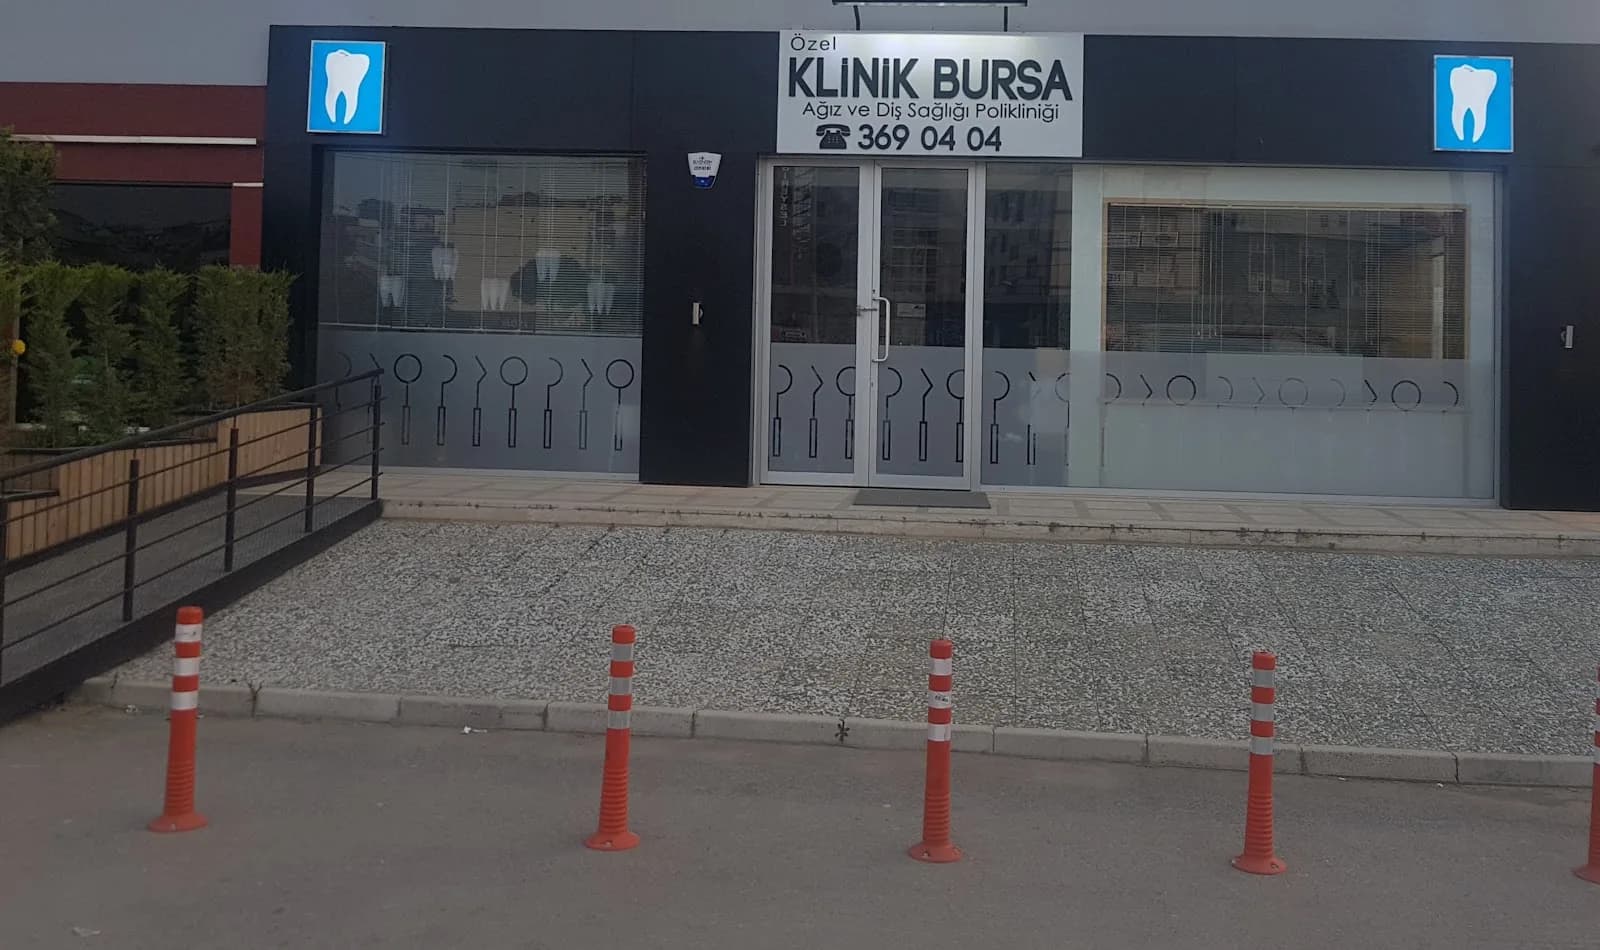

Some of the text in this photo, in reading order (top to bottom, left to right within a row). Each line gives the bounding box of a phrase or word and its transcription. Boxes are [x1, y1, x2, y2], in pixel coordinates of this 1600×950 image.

[790, 33, 837, 51] Özel
[933, 58, 1073, 101] BURSA
[802, 101, 1059, 123] Ağız ve Diş Sağlığı Polikliniği
[857, 124, 1002, 151] 369 04 04
